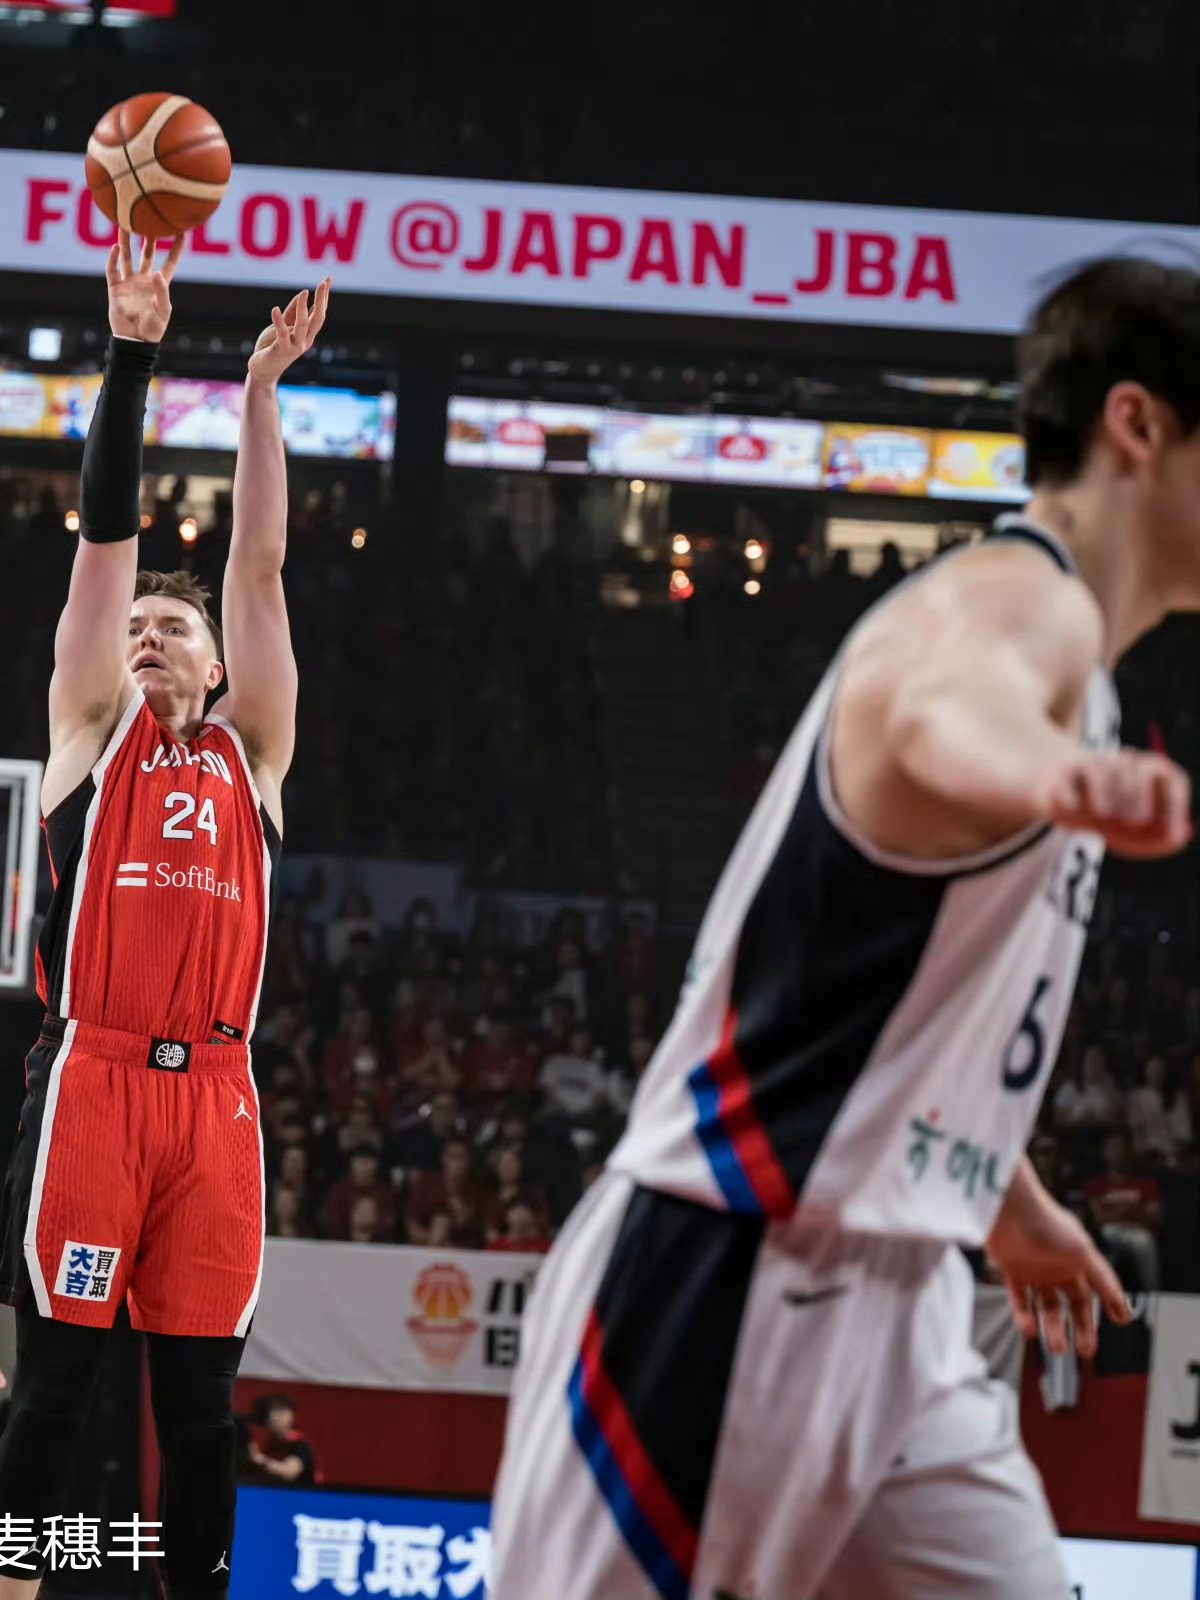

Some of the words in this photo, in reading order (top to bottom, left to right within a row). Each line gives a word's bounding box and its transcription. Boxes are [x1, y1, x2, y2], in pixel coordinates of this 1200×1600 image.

[390, 201, 957, 304] @JAPAN_JBA
[162, 791, 218, 846] 24
[65, 1246, 95, 1297] 大吉
[88, 1249, 116, 1298] 買取
